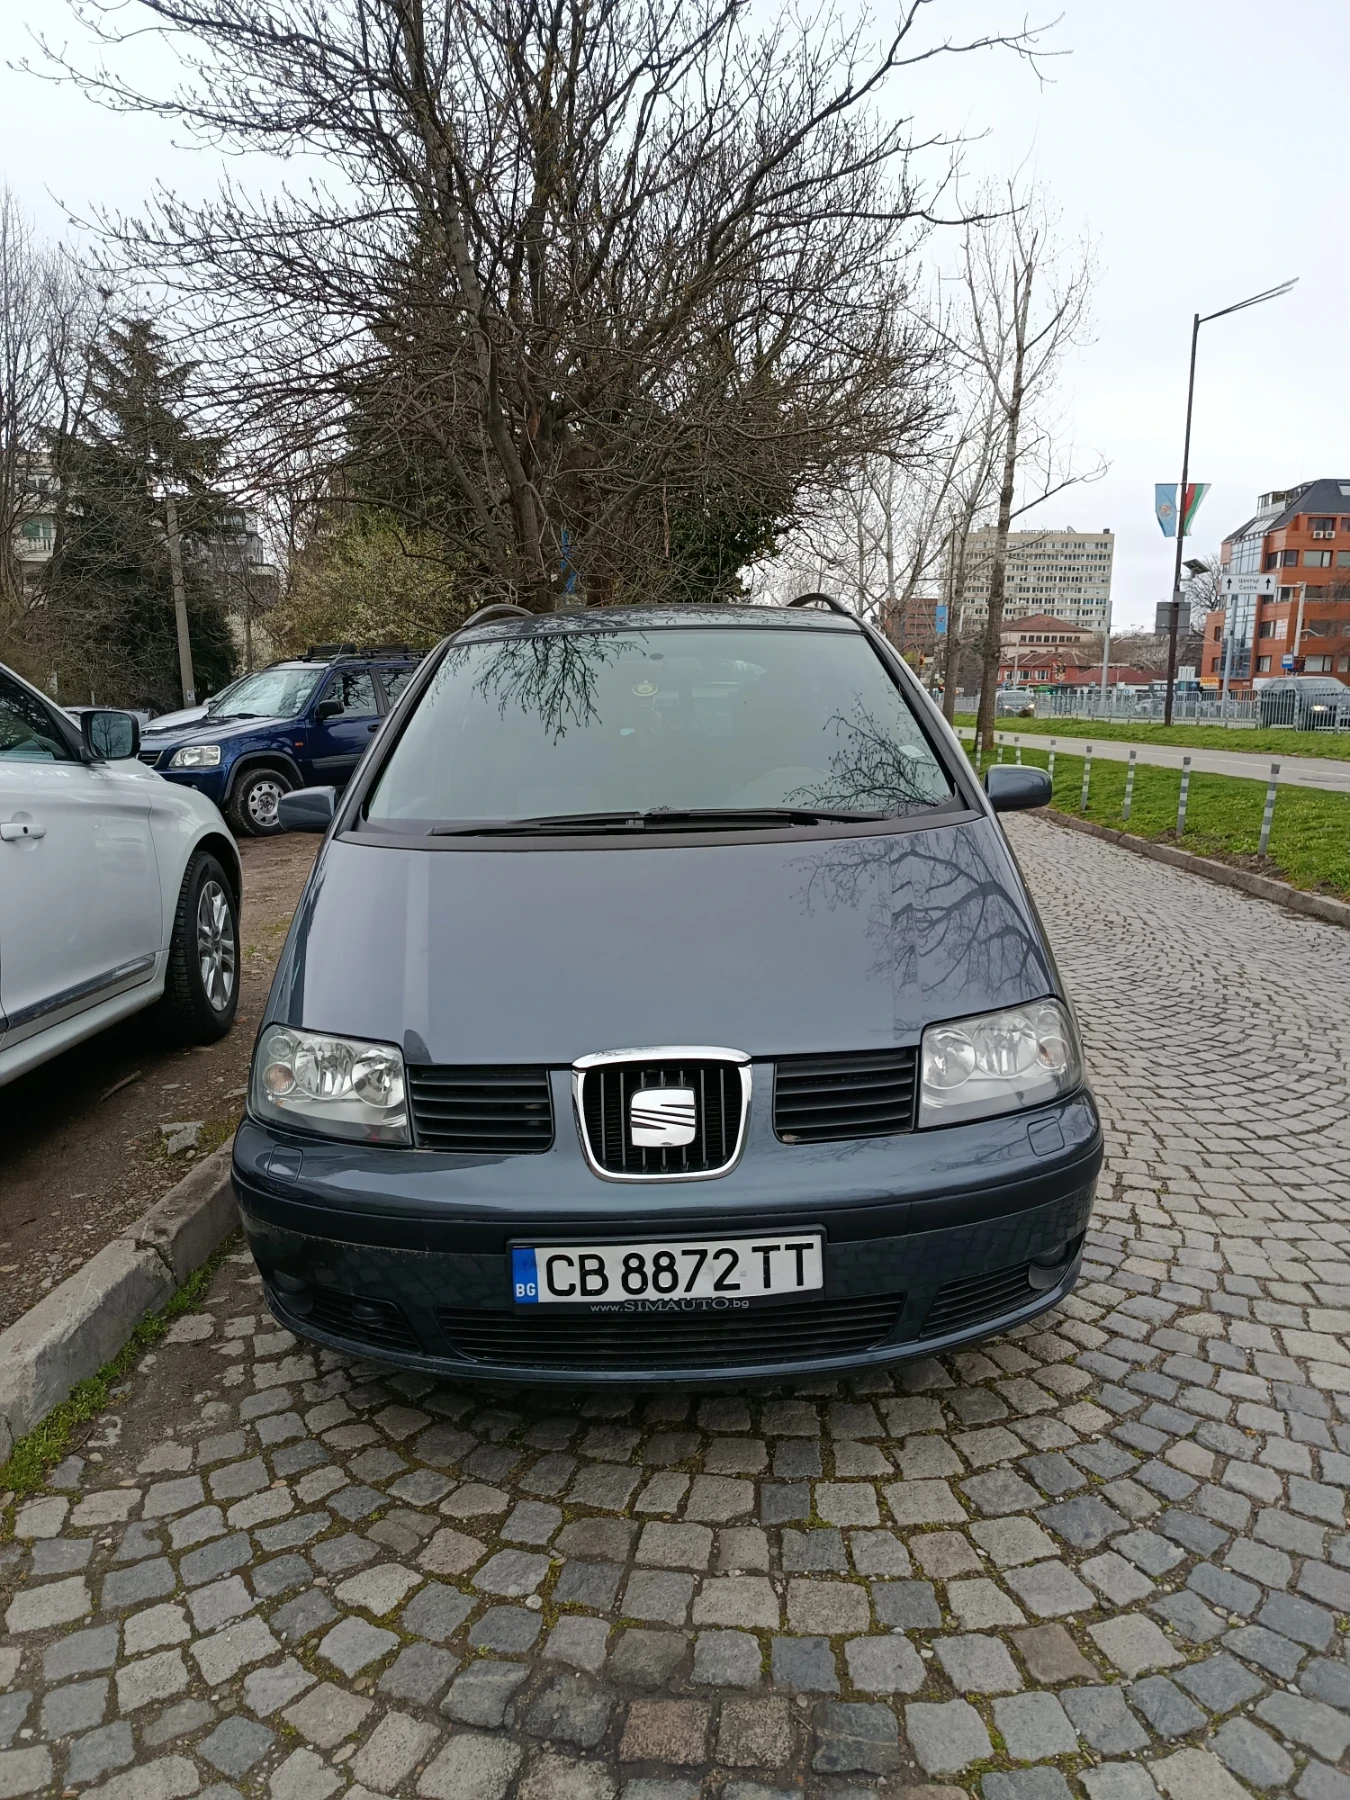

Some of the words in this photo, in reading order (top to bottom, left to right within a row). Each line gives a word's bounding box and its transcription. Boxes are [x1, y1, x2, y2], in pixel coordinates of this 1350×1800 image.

[545, 1253, 609, 1297] CB
[621, 1247, 741, 1295] 8872
[751, 1242, 814, 1289] TT
[515, 1282, 536, 1297] BG
[590, 1298, 750, 1312] www.SIMAUTO.bg
